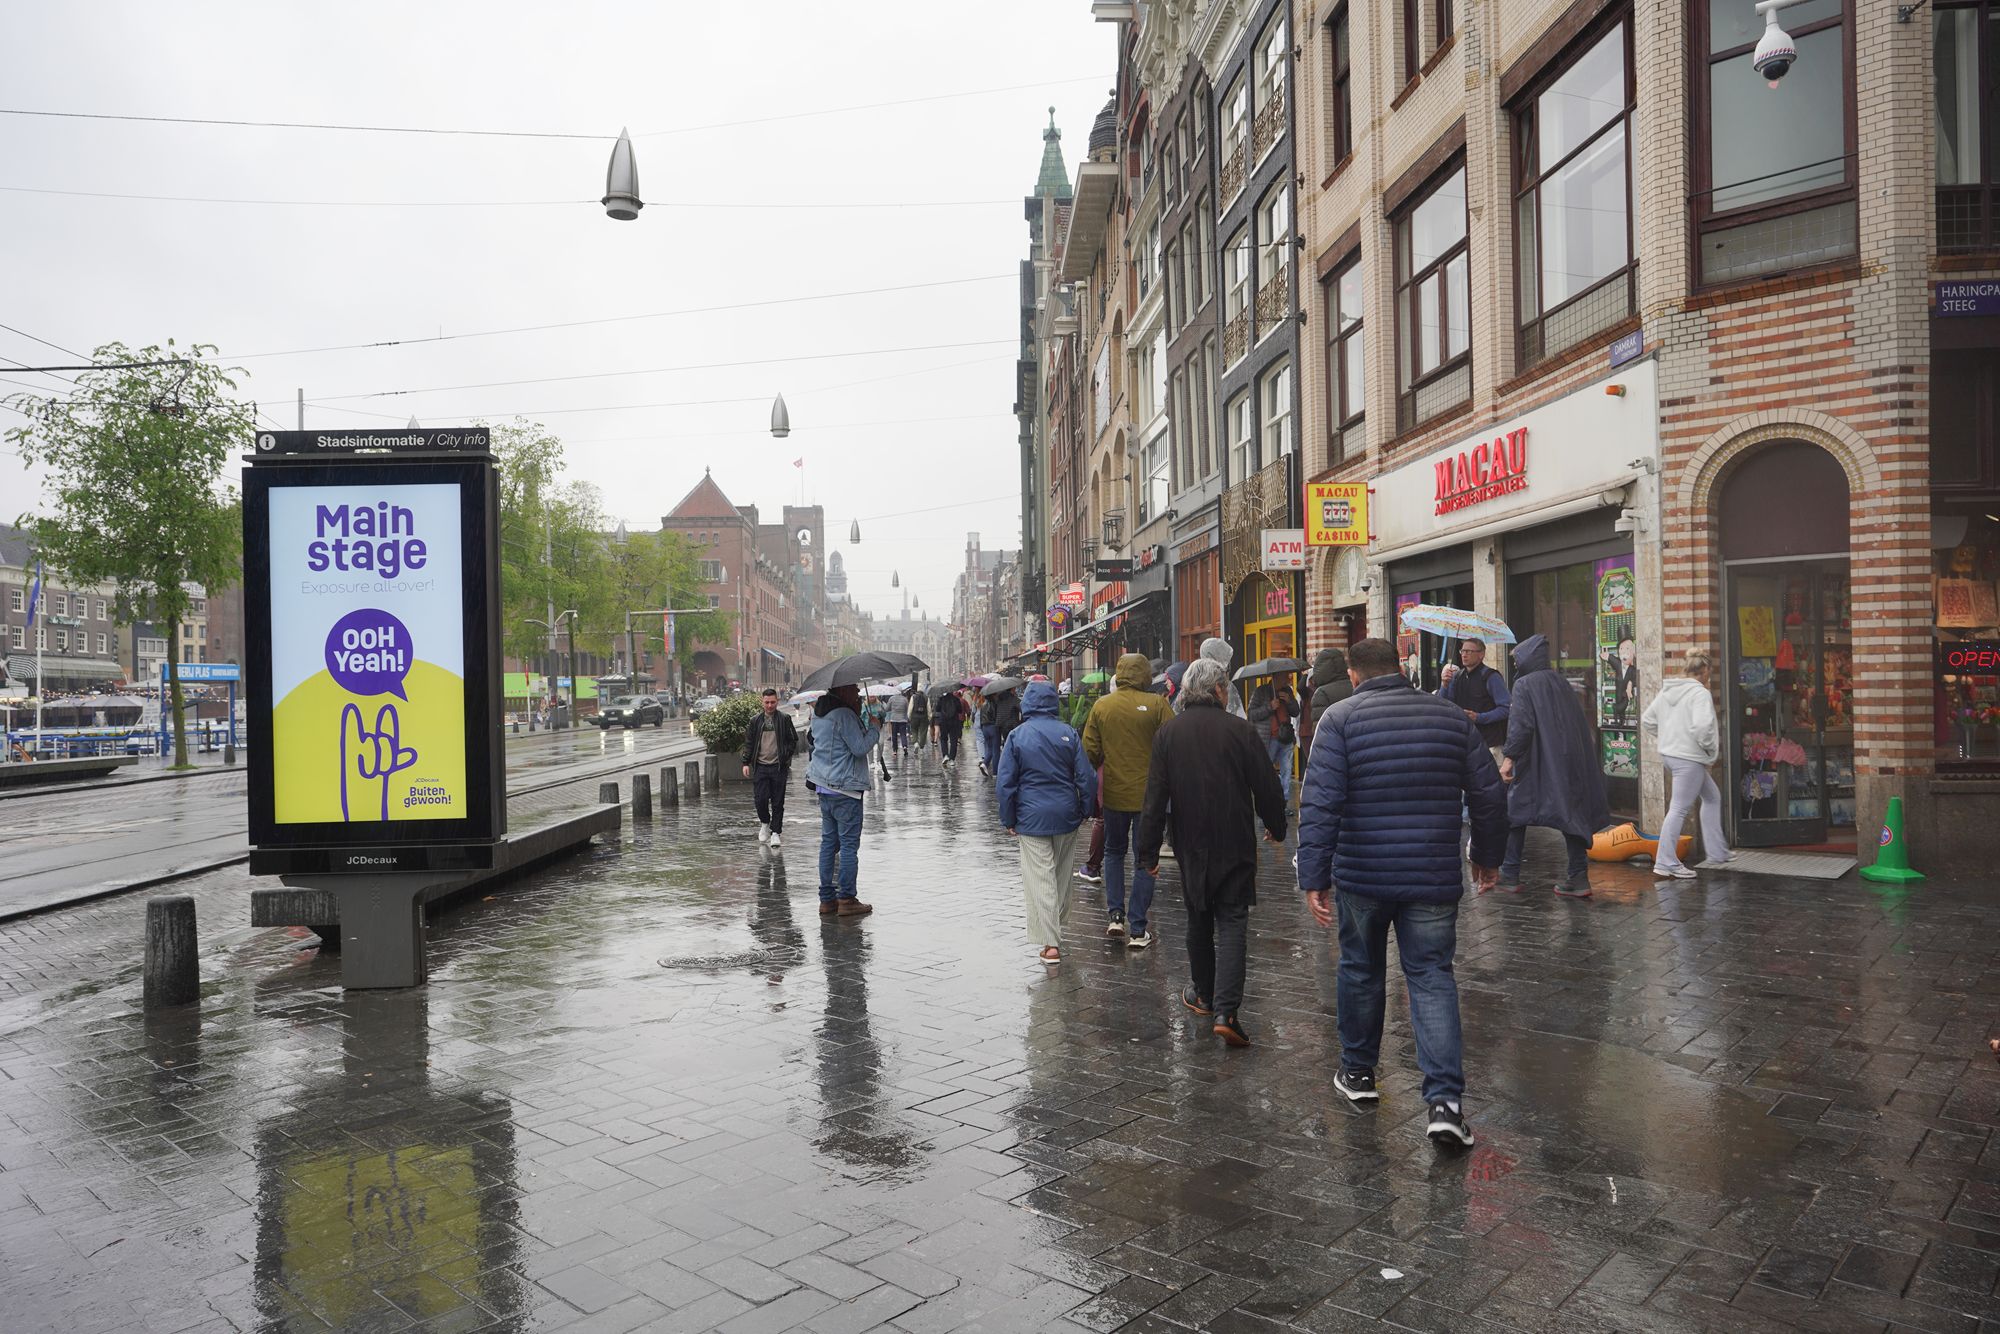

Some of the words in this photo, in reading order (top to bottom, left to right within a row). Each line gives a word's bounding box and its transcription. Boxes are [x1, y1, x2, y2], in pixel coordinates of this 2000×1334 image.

[1942, 299, 1976, 312] STEEG
[1614, 336, 1637, 355] DAMRAK
[317, 435, 425, 448] Stadsinformatie
[436, 433, 462, 448] City
[463, 433, 486, 445] info
[1434, 426, 1528, 501] MACAU
[1316, 487, 1359, 498] MACAU
[316, 501, 414, 538] Main
[1316, 531, 1360, 541] CASINO
[1269, 542, 1302, 554] ATM
[307, 538, 427, 580] stage
[301, 580, 370, 597] Exposure
[373, 579, 435, 593] all-over!
[1265, 588, 1290, 616] CUTE
[342, 626, 395, 650] OOH
[333, 648, 405, 673] Yeah!
[409, 786, 446, 797] Buiten
[403, 794, 452, 808] gewoon!
[346, 855, 398, 865] JCDecaux
